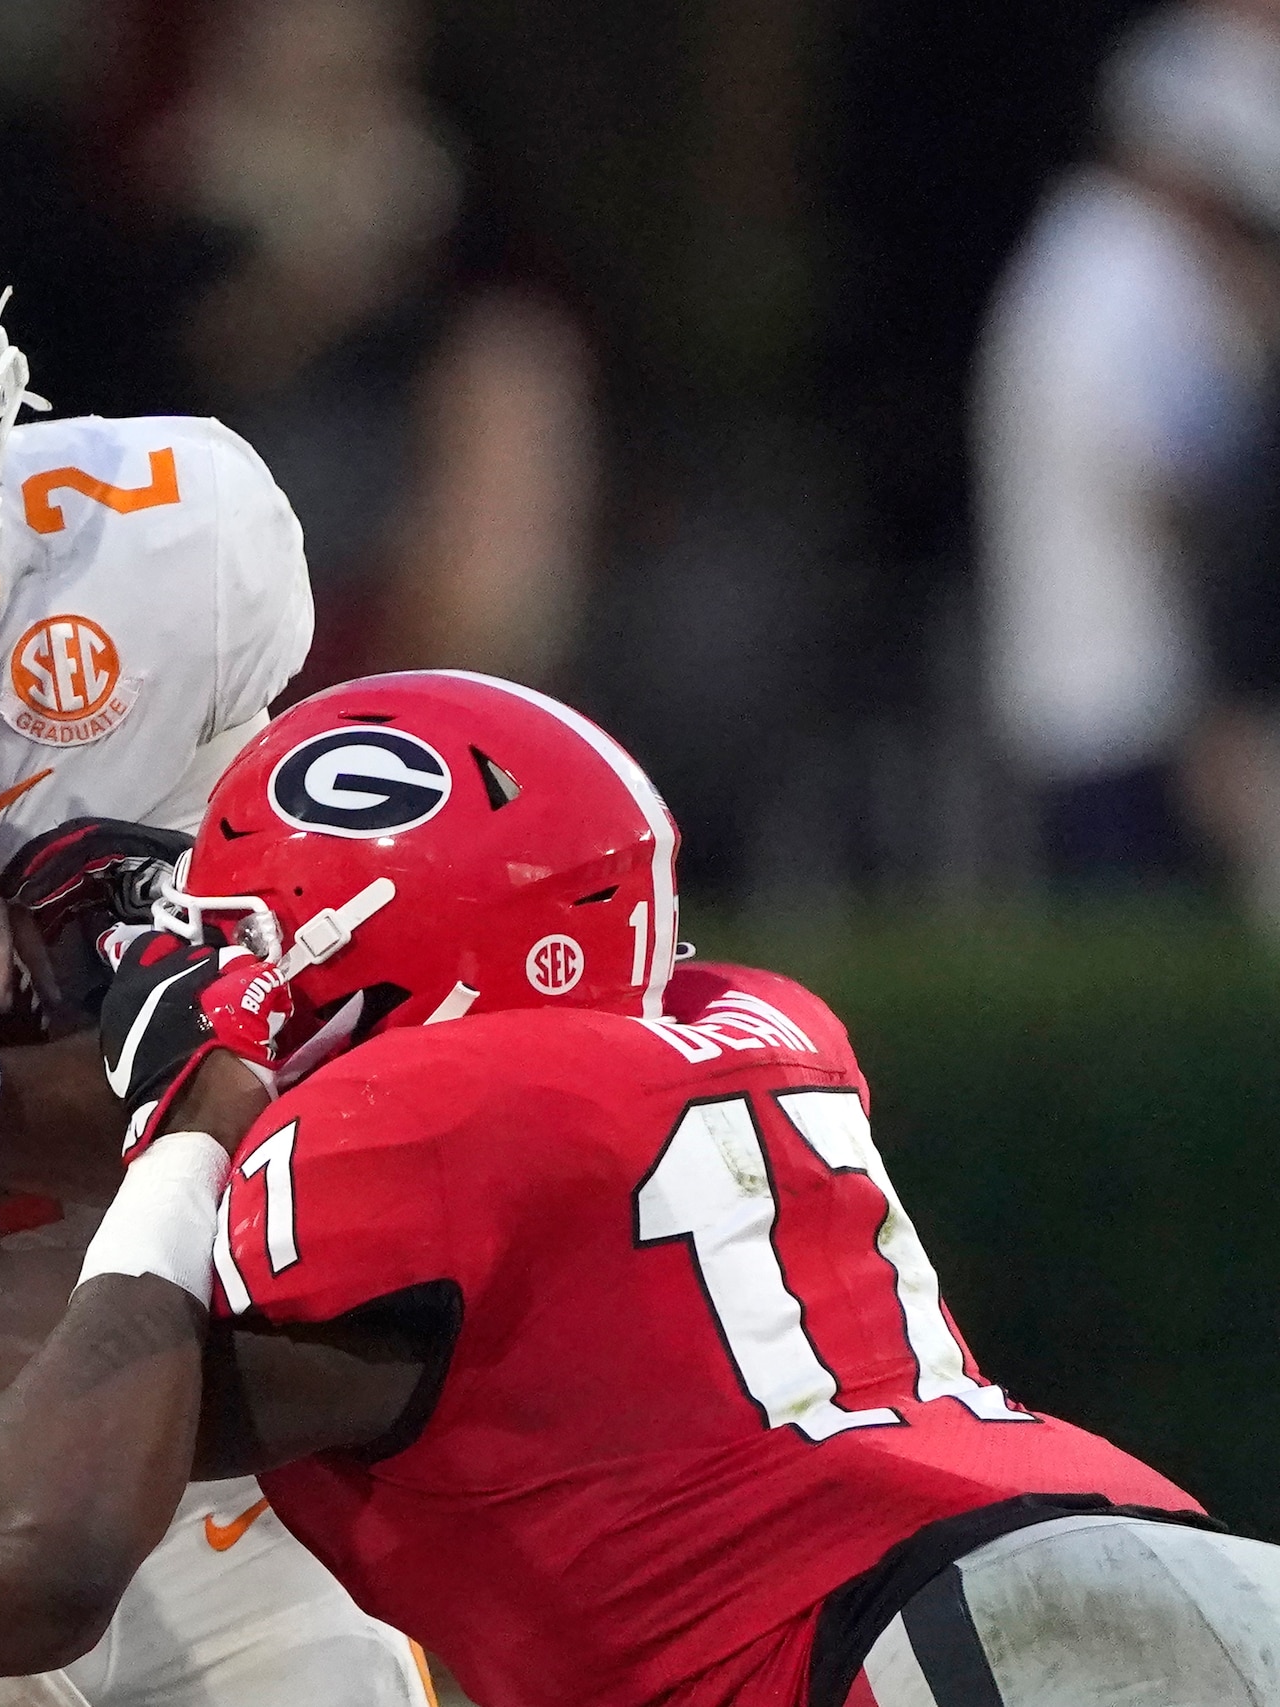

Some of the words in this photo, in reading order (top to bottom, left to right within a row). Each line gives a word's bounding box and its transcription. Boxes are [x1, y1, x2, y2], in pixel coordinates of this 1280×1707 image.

[22, 447, 181, 534] 2
[19, 621, 111, 713] SEC
[16, 699, 127, 743] GRADUATE
[271, 728, 448, 834] G
[531, 939, 580, 990] SEC
[628, 990, 818, 1064] DEAN
[631, 1086, 1046, 1446] 17
